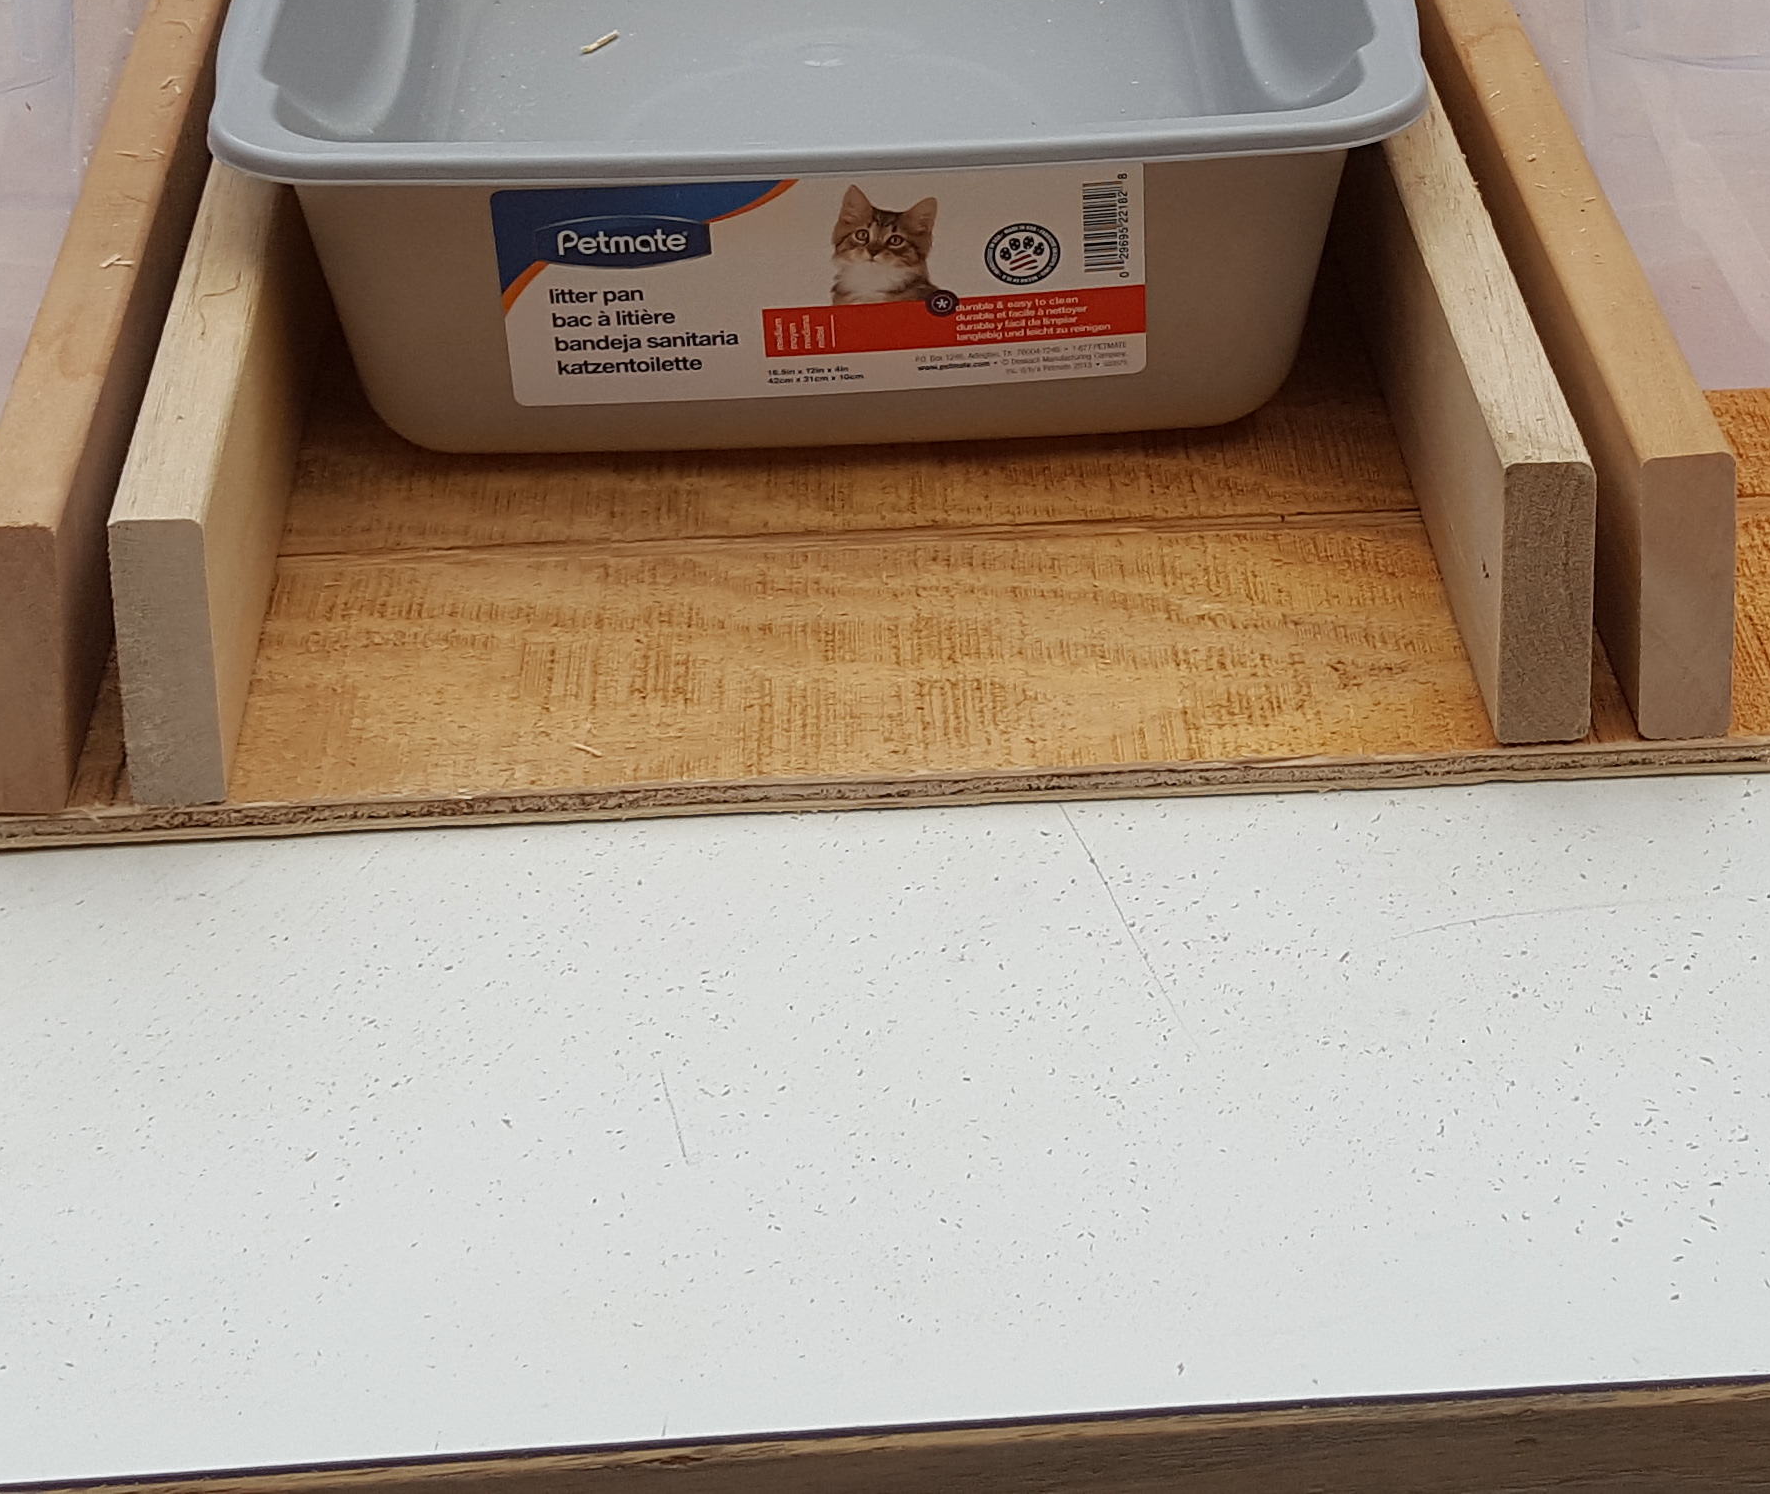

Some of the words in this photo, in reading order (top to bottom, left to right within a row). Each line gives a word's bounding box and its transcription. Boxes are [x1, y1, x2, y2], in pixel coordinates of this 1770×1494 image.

[1117, 172, 1128, 180] 8
[1117, 191, 1129, 224] 22182
[1118, 227, 1130, 260] 29695
[548, 288, 598, 304] litter
[603, 289, 644, 306] pan
[955, 302, 994, 312] durable
[1007, 300, 1032, 309] easy
[1035, 298, 1046, 307] to
[1048, 296, 1079, 305] clean
[552, 312, 593, 328] bac
[597, 310, 611, 327] à
[615, 309, 676, 326] litière
[955, 311, 995, 322] durable
[996, 310, 1007, 320] et
[1008, 308, 1035, 319] facile
[1046, 305, 1088, 317] nettoyer
[956, 321, 995, 332] durable
[996, 321, 1004, 331] y
[1028, 317, 1041, 327] de
[1042, 315, 1078, 327] limpiar
[956, 331, 1003, 342] langlebig
[1004, 329, 1025, 338] und
[1026, 326, 1055, 337] leicht
[1056, 327, 1069, 335] zu
[1070, 322, 1112, 334] reinigen
[554, 334, 642, 353] bandeja
[647, 330, 740, 348] sanitaria
[557, 356, 703, 376] katzentoilette
